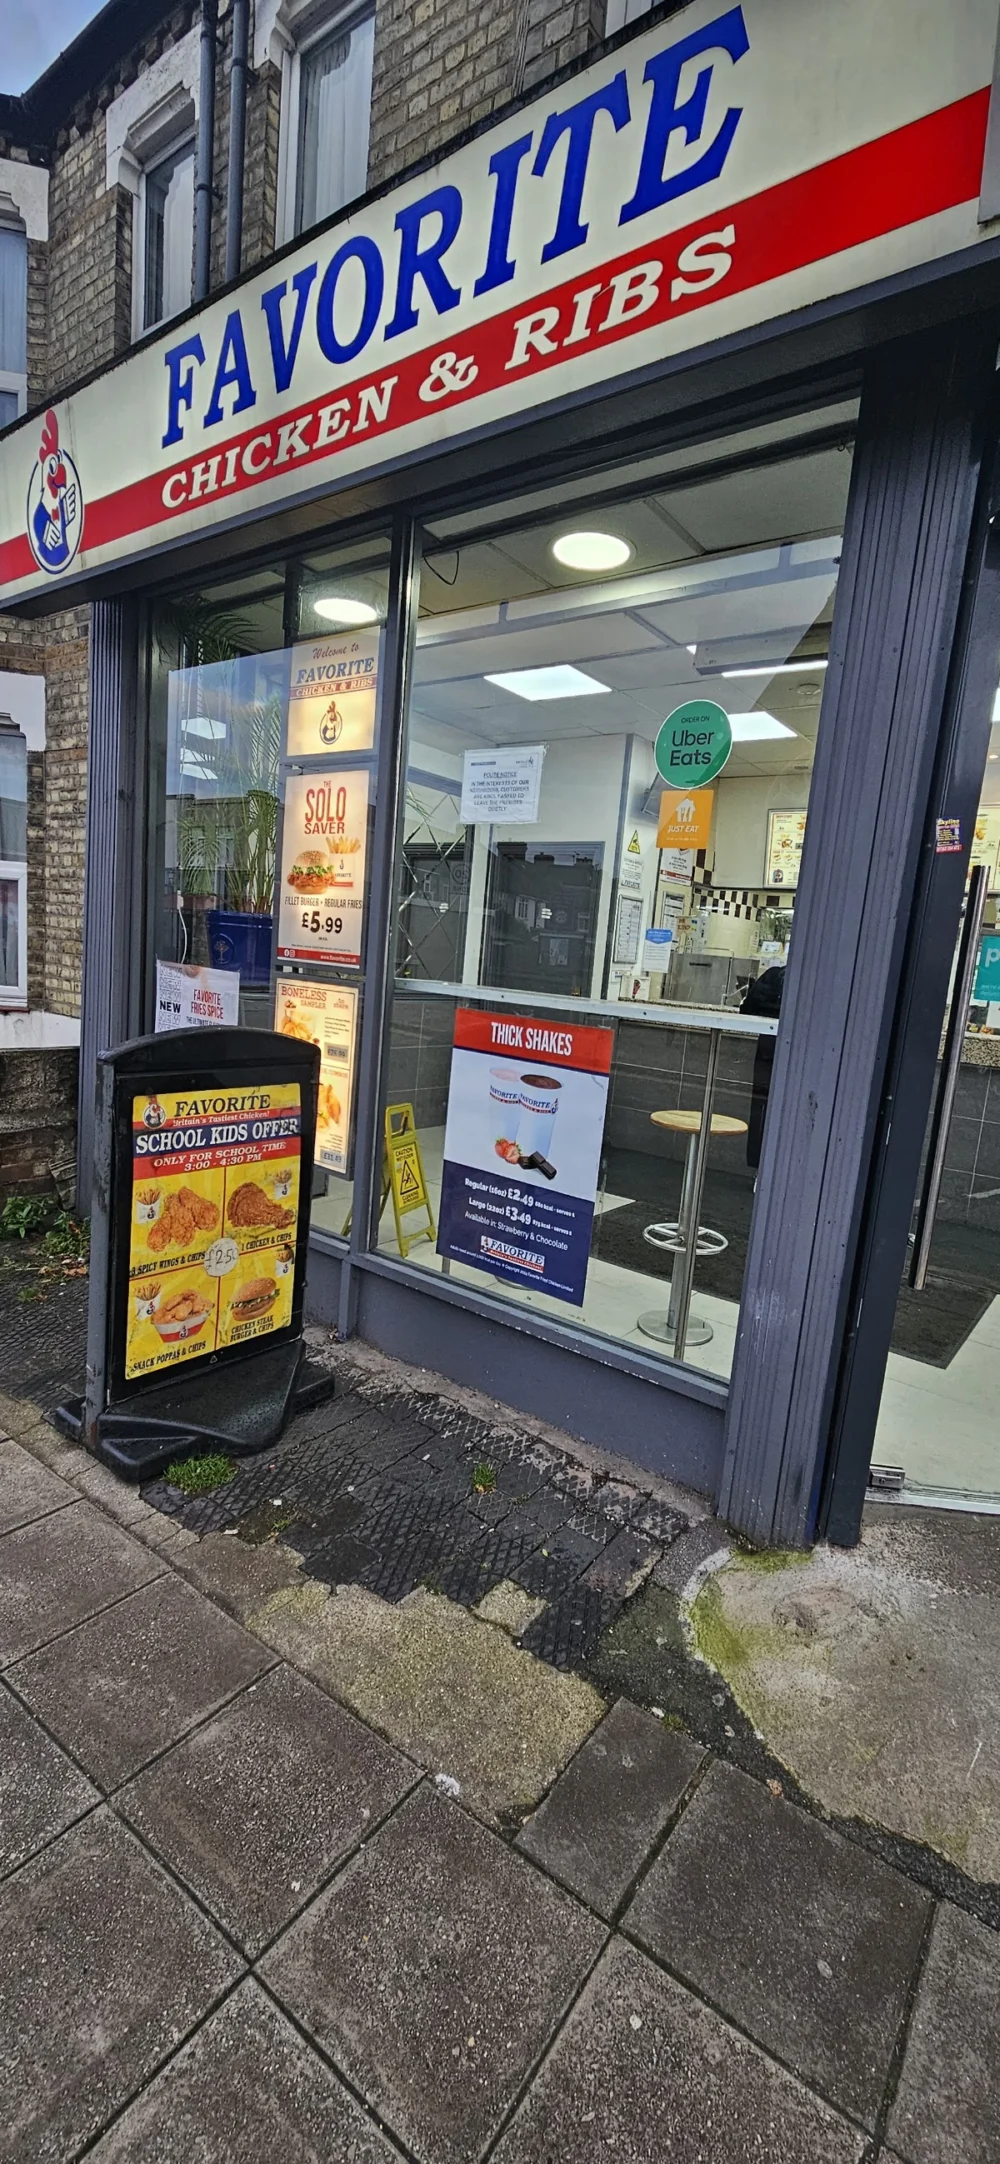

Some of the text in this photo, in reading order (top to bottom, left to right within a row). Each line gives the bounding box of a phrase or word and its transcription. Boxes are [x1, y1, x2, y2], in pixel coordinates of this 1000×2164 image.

[161, 5, 750, 449] FAVORITE
[160, 225, 737, 510] CHICKEN & RIBS
[312, 642, 359, 659] Welcome to
[296, 657, 375, 684] FAVORITE
[296, 682, 337, 697] CHICKEN
[350, 678, 373, 689] RIBS
[681, 716, 700, 724] ORDER
[671, 730, 714, 747] Uber
[669, 749, 712, 767] Eats
[323, 780, 332, 788] THE
[305, 786, 347, 823] SOLO
[304, 822, 346, 835] SAVER
[668, 825, 699, 833] JUST EAT
[285, 896, 300, 906] FILLET
[300, 897, 319, 907] BURGER
[324, 898, 346, 909] REGULAR
[347, 900, 362, 909] FRIES
[302, 911, 343, 934] £5.99
[194, 989, 221, 1006] FAVORITE
[281, 986, 327, 1002] BONELESS
[160, 1000, 181, 1014] NEW
[191, 1002, 224, 1019] FRIES SPICE
[300, 1000, 326, 1010] SAMPLER
[491, 1022, 573, 1056] THICK SHAKES
[174, 1094, 271, 1117] FAVORITE
[173, 1111, 270, 1127] Britain's Tastiest Chicken!
[136, 1118, 300, 1154] SCHOOL KIDS OFFER
[153, 1141, 287, 1167] ONLY FOR SCHOOL TIME
[395, 1147, 413, 1157] CAUTION
[184, 1161, 210, 1171] 3:00
[219, 1156, 243, 1166] 4:30
[246, 1153, 262, 1162] PM
[465, 1178, 489, 1192] Regular
[489, 1185, 507, 1198] (16oz)
[507, 1188, 534, 1207] £2.49
[469, 1197, 486, 1209] Large
[486, 1203, 504, 1215] (22oz)
[505, 1206, 531, 1225] £3.49
[465, 1211, 489, 1226] Available
[497, 1220, 529, 1240] Strawberry
[530, 1232, 535, 1241] &
[535, 1234, 568, 1251] Chocolate
[246, 1238, 269, 1251] CHICKEN
[276, 1233, 292, 1245] CHIPS
[490, 1240, 544, 1265] FAVORITE
[137, 1262, 158, 1275] SPICY
[159, 1256, 180, 1269] WINGS
[180, 1256, 186, 1264] &
[187, 1251, 206, 1262] CHIPS
[230, 1328, 252, 1342] BURGER
[258, 1322, 274, 1333] CHIPS
[231, 1315, 274, 1334] CHICKEN STEAK
[133, 1358, 155, 1372] SNACK
[156, 1350, 180, 1364] POPPAS
[188, 1341, 206, 1353] CHIPS
